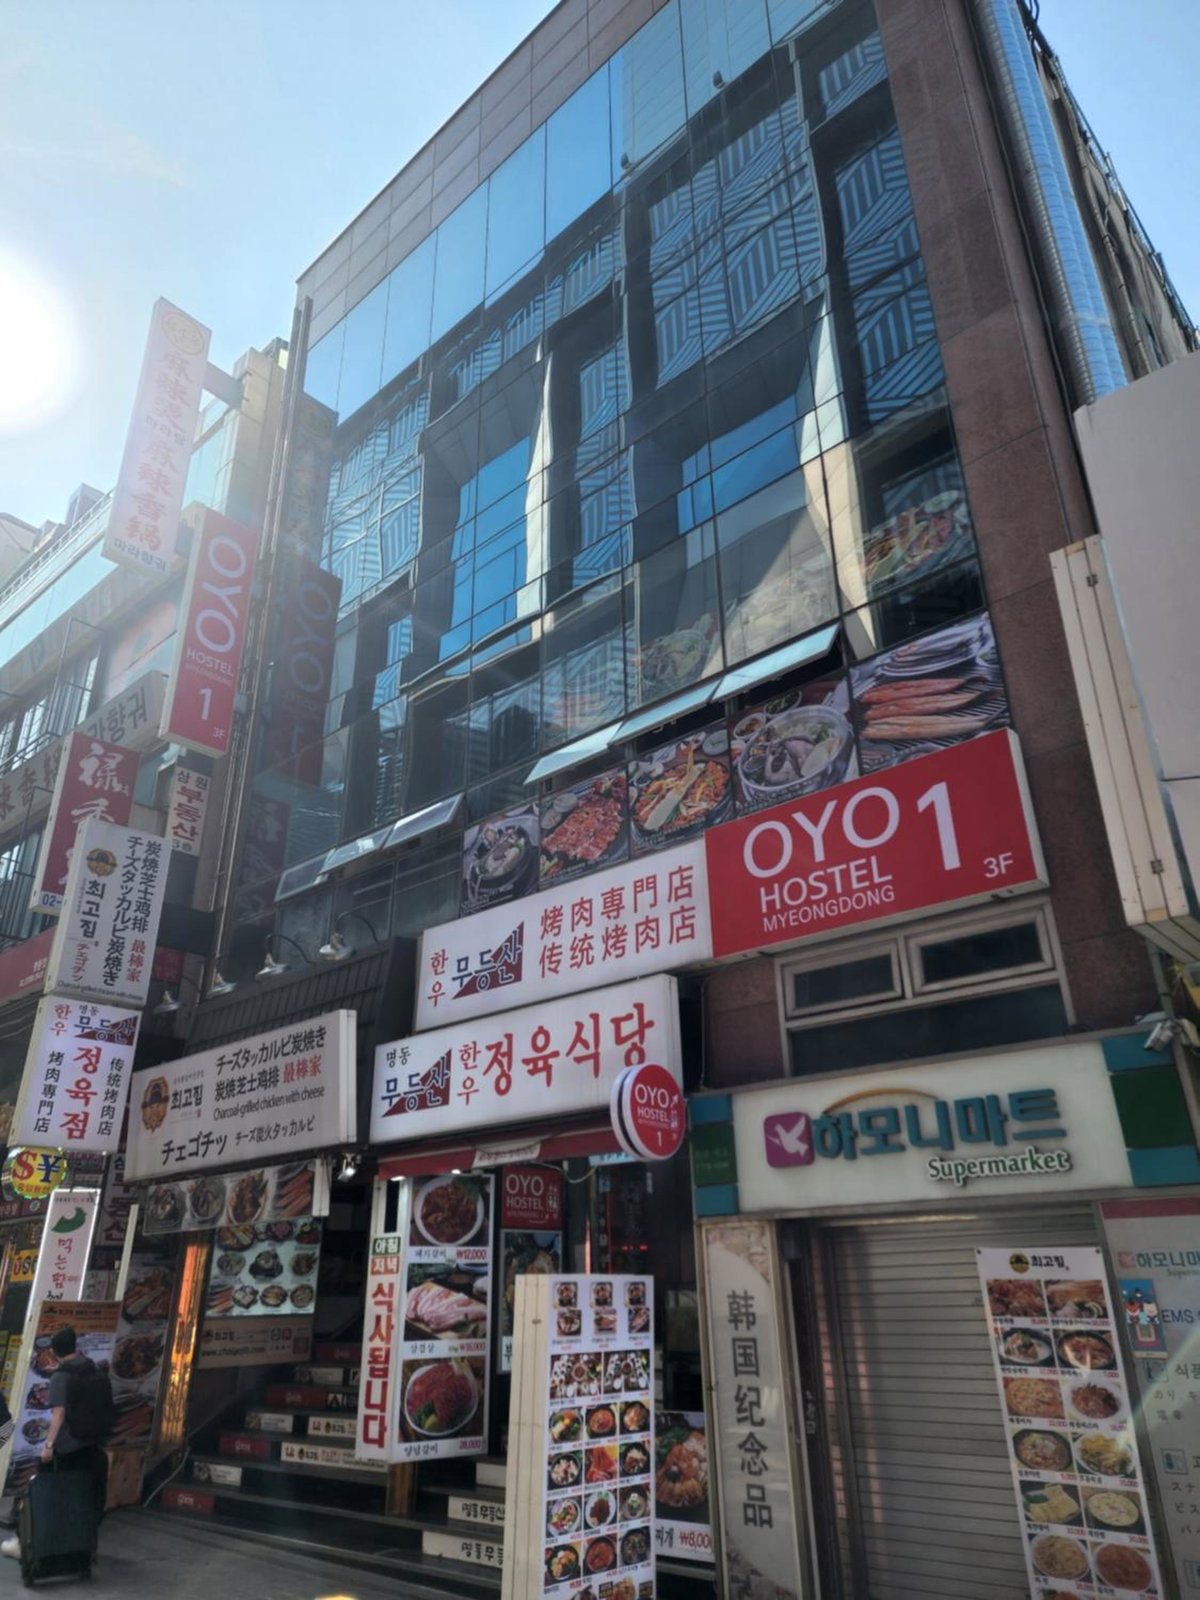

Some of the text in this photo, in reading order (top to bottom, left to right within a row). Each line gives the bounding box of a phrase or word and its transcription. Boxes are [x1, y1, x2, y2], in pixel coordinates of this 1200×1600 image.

[195, 536, 247, 653] OYO
[186, 647, 234, 677] HOSTEL
[200, 688, 213, 721] 1
[171, 785, 204, 842] 부동산
[743, 781, 961, 878] OYO 1
[983, 852, 1014, 878] 3F
[760, 855, 893, 913] HOSTEL
[80, 880, 107, 939] 최고집
[103, 836, 143, 986] チーズタッカルビ炭焼き
[763, 885, 895, 933] MYEONGDONG
[539, 905, 697, 979] 传统烤肉店
[427, 949, 449, 1007] 한우
[452, 930, 524, 992] 무등산
[50, 1004, 72, 1037] 한우
[79, 1004, 99, 1017] 명동
[74, 1014, 136, 1044] 무등산
[216, 1025, 327, 1076] チーズタッカルビ炭焼き
[385, 1046, 411, 1069] 명동
[482, 1002, 655, 1096] 정육식당
[381, 1055, 451, 1111] 무등산
[456, 1041, 482, 1105] 한우
[60, 1046, 102, 1140] 정육점
[97, 1057, 125, 1136] 传统烤肉店
[170, 1083, 203, 1111] 최고집
[259, 1095, 283, 1112] chicken
[284, 1091, 300, 1106] with
[300, 1085, 325, 1103] cheese
[634, 1083, 669, 1108] OYO
[637, 1106, 670, 1124] HOSTEL
[812, 1088, 1067, 1161] 하모니마트
[162, 1131, 228, 1166] チェゴチッ
[656, 1131, 663, 1147] 1
[506, 1173, 544, 1196] OYO
[929, 1148, 1070, 1186] Supermarket
[506, 1196, 544, 1211] HOSTEL
[375, 1239, 399, 1255] 아침
[456, 1249, 487, 1260] ₩12,000
[1031, 1255, 1065, 1268] 최고집
[373, 1257, 398, 1274] 저녁
[1162, 1310, 1194, 1324] EMS
[363, 1283, 395, 1449] 식사됩니다
[727, 1290, 773, 1529] 韩国纪念品
